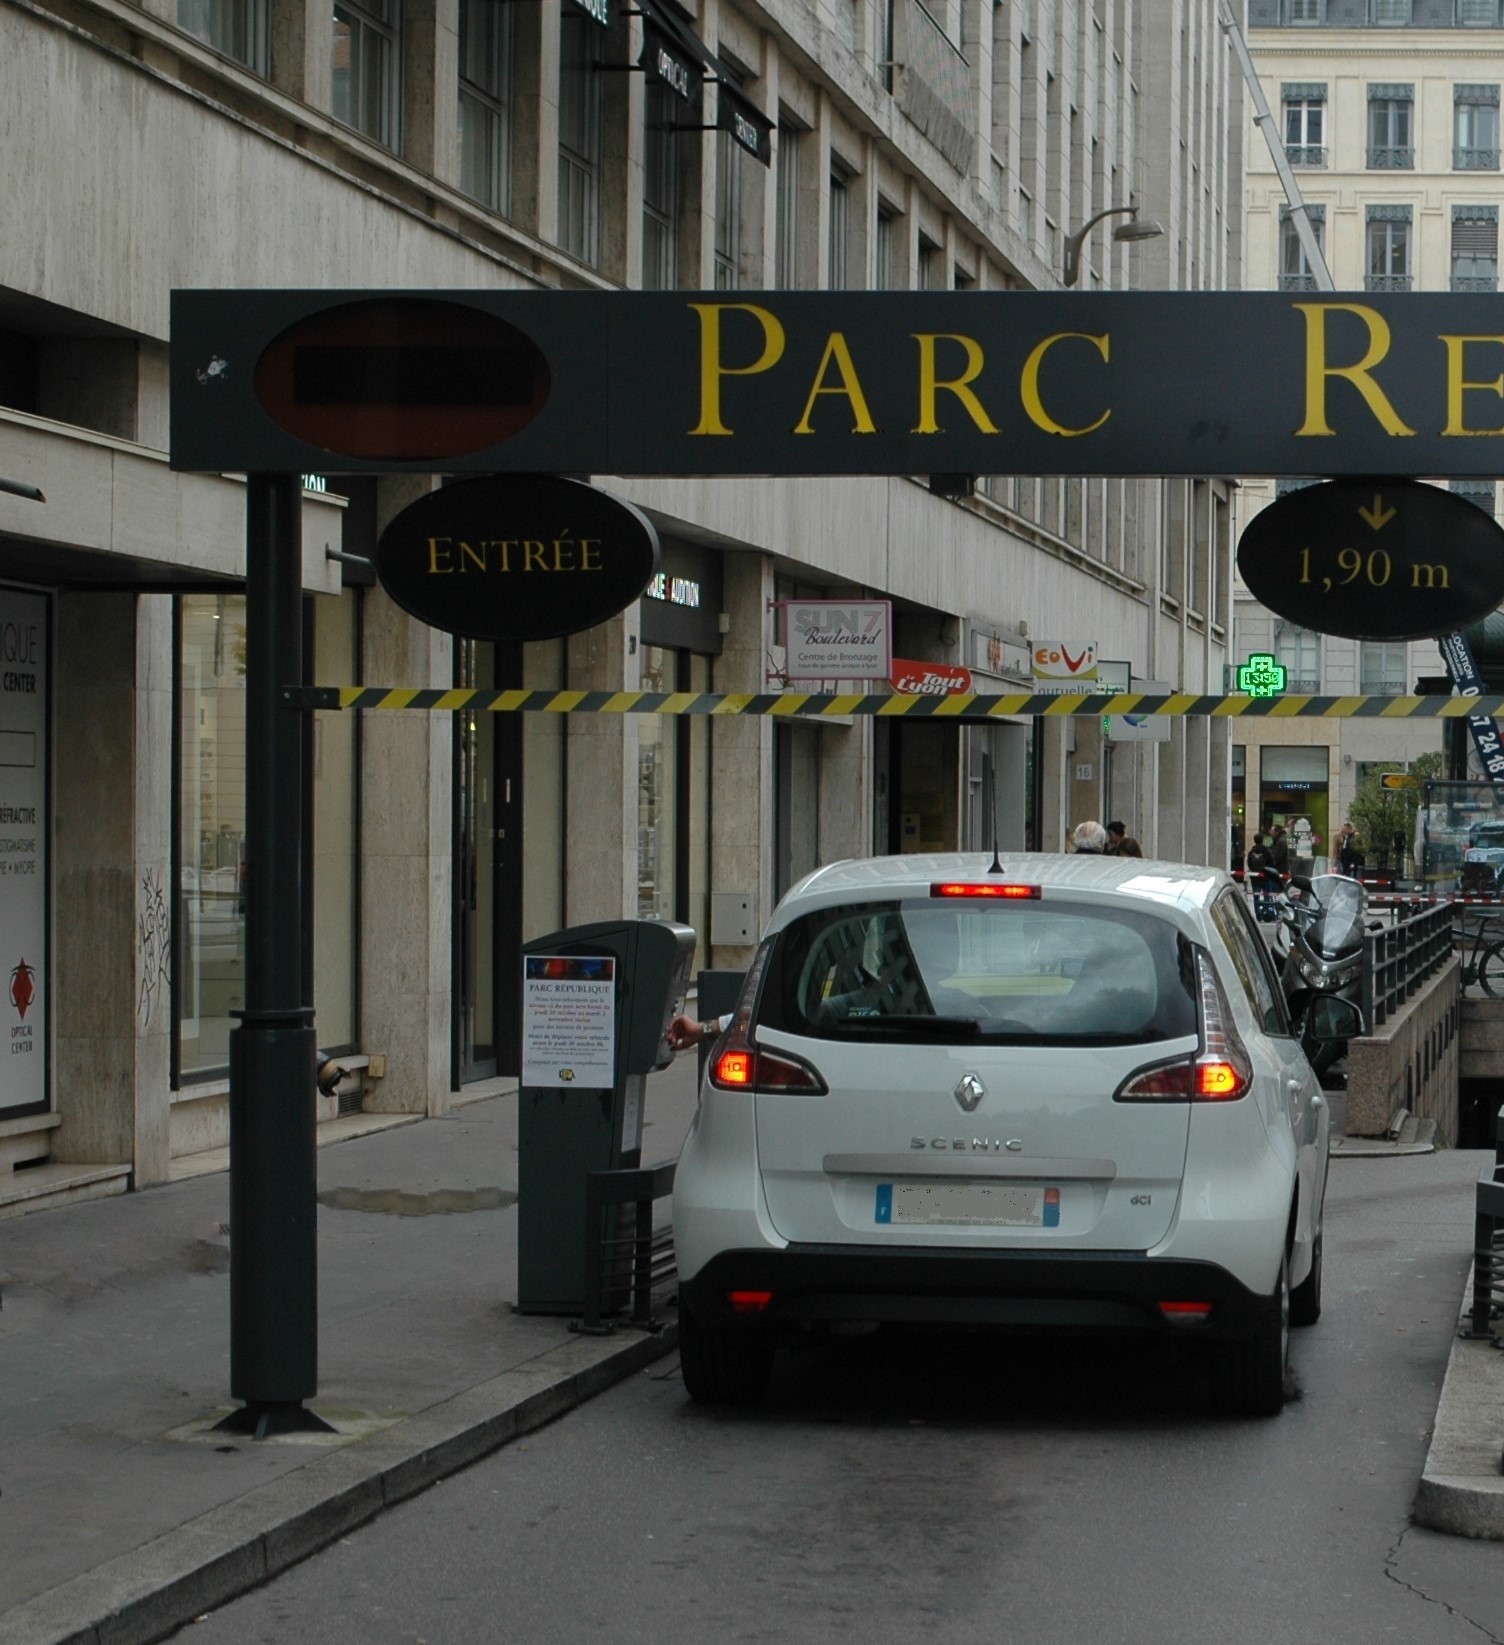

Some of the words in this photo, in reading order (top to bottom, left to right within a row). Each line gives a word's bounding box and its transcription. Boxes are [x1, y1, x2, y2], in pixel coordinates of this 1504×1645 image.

[657, 48, 689, 98] OPTICAL
[687, 301, 1112, 438] PARC
[427, 529, 603, 575] ENTRÉE
[1297, 546, 1392, 592] 1,90
[1411, 560, 1450, 589] m
[794, 609, 859, 634] SUN
[863, 610, 882, 633] 7
[804, 625, 883, 646] Boulevard
[840, 652, 878, 663] Bronzage
[1450, 631, 1475, 680] LOCATION
[4, 671, 36, 693] CENTER
[897, 677, 949, 695] Lyon
[923, 671, 966, 689] Tout
[1477, 732, 1500, 754] 24
[529, 984, 552, 993] PARC
[11, 1041, 33, 1054] CENTER
[909, 1135, 1024, 1152] SCENIC
